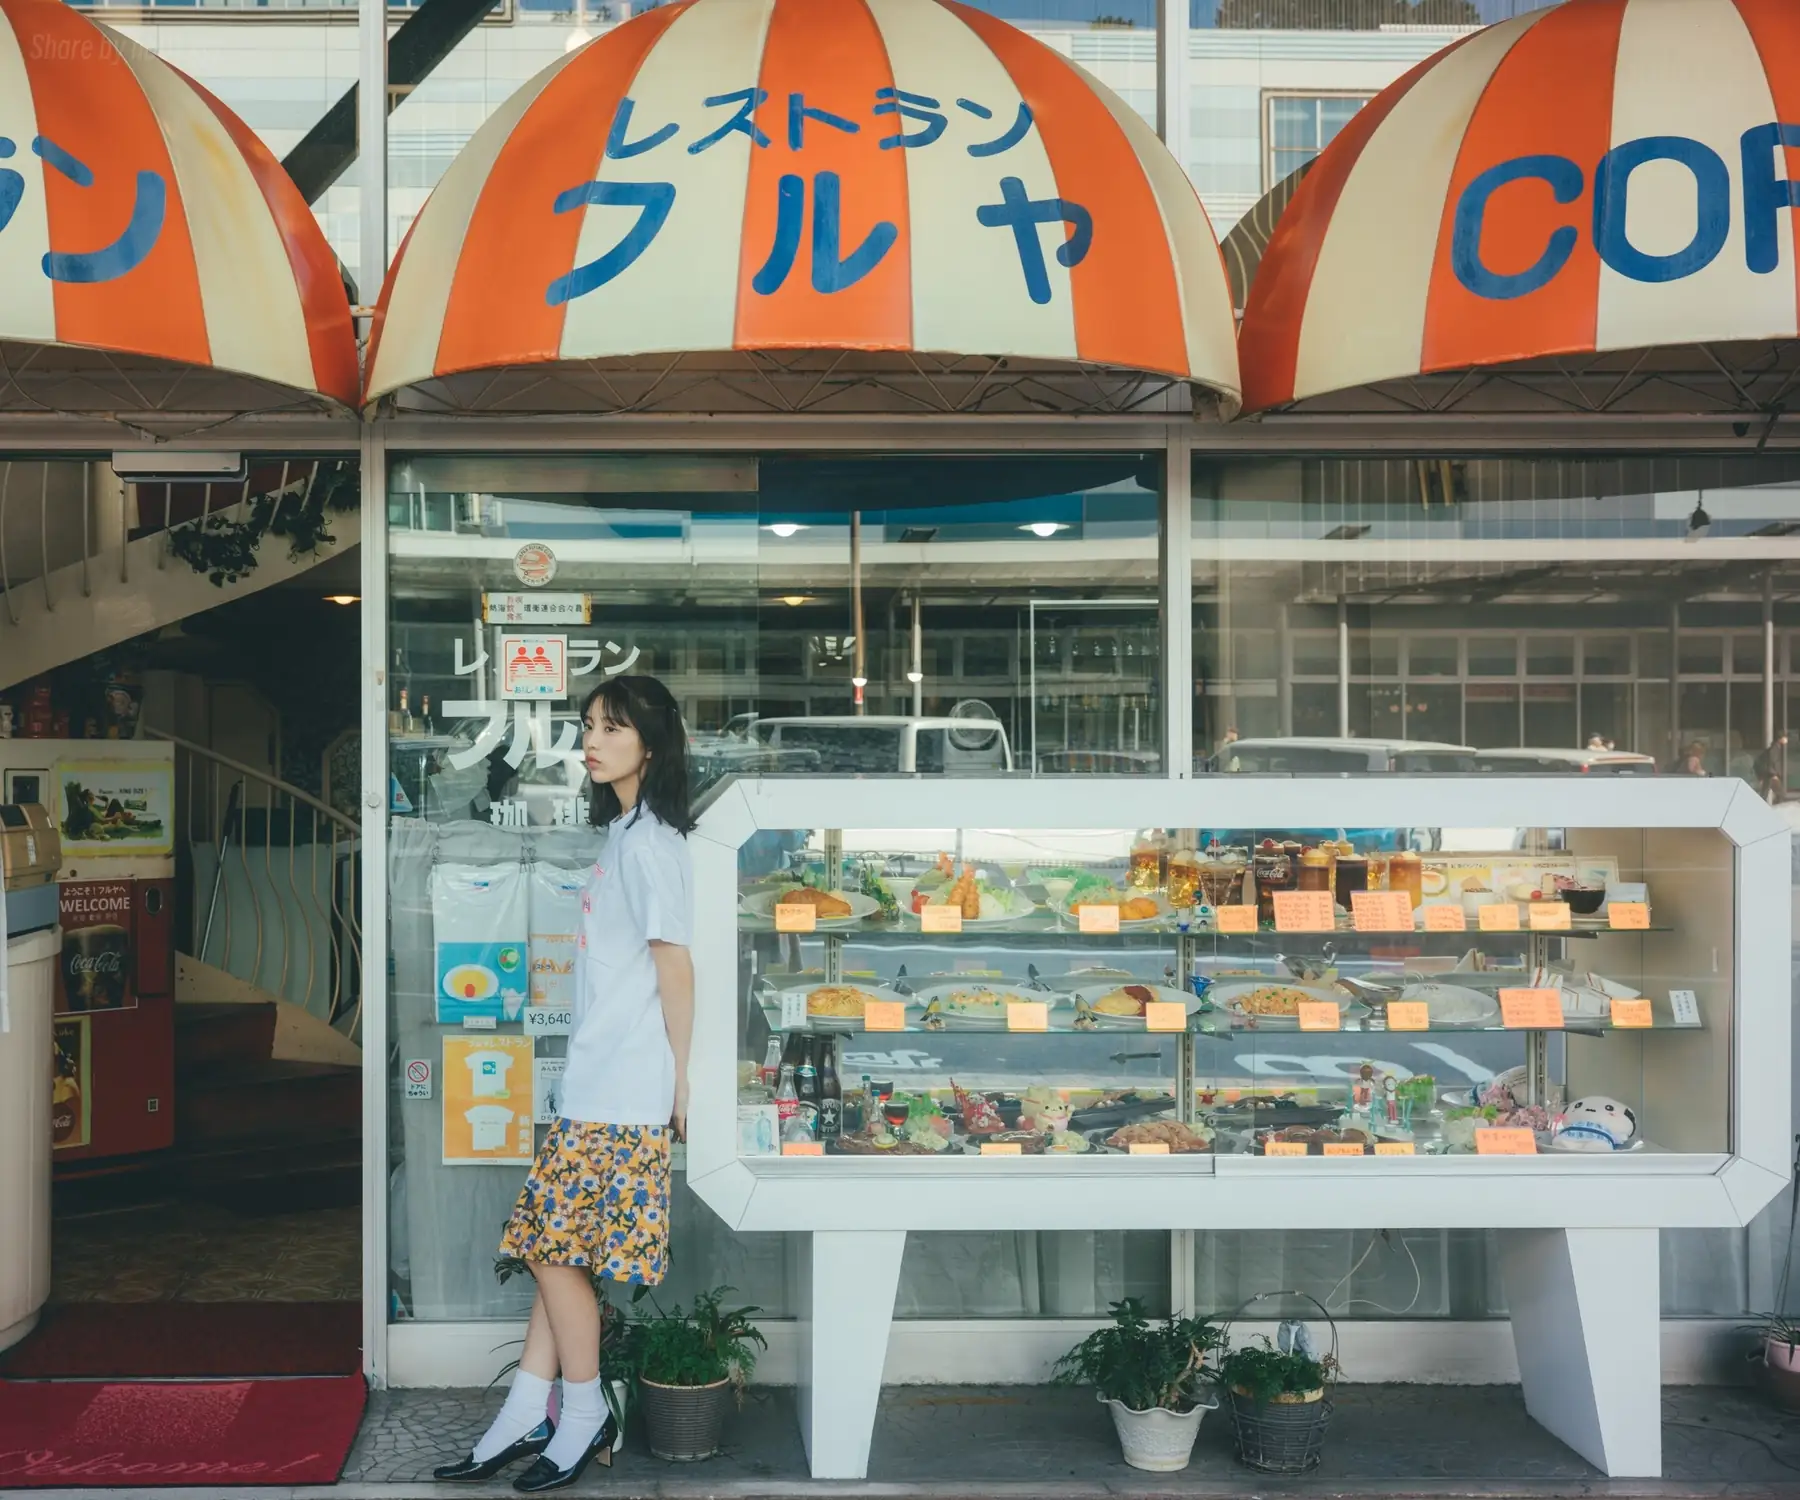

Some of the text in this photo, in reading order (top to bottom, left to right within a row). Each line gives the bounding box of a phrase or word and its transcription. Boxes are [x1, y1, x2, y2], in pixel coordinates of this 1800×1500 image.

[606, 87, 1034, 160] レストラン
[60, 897, 131, 913] WELCOME
